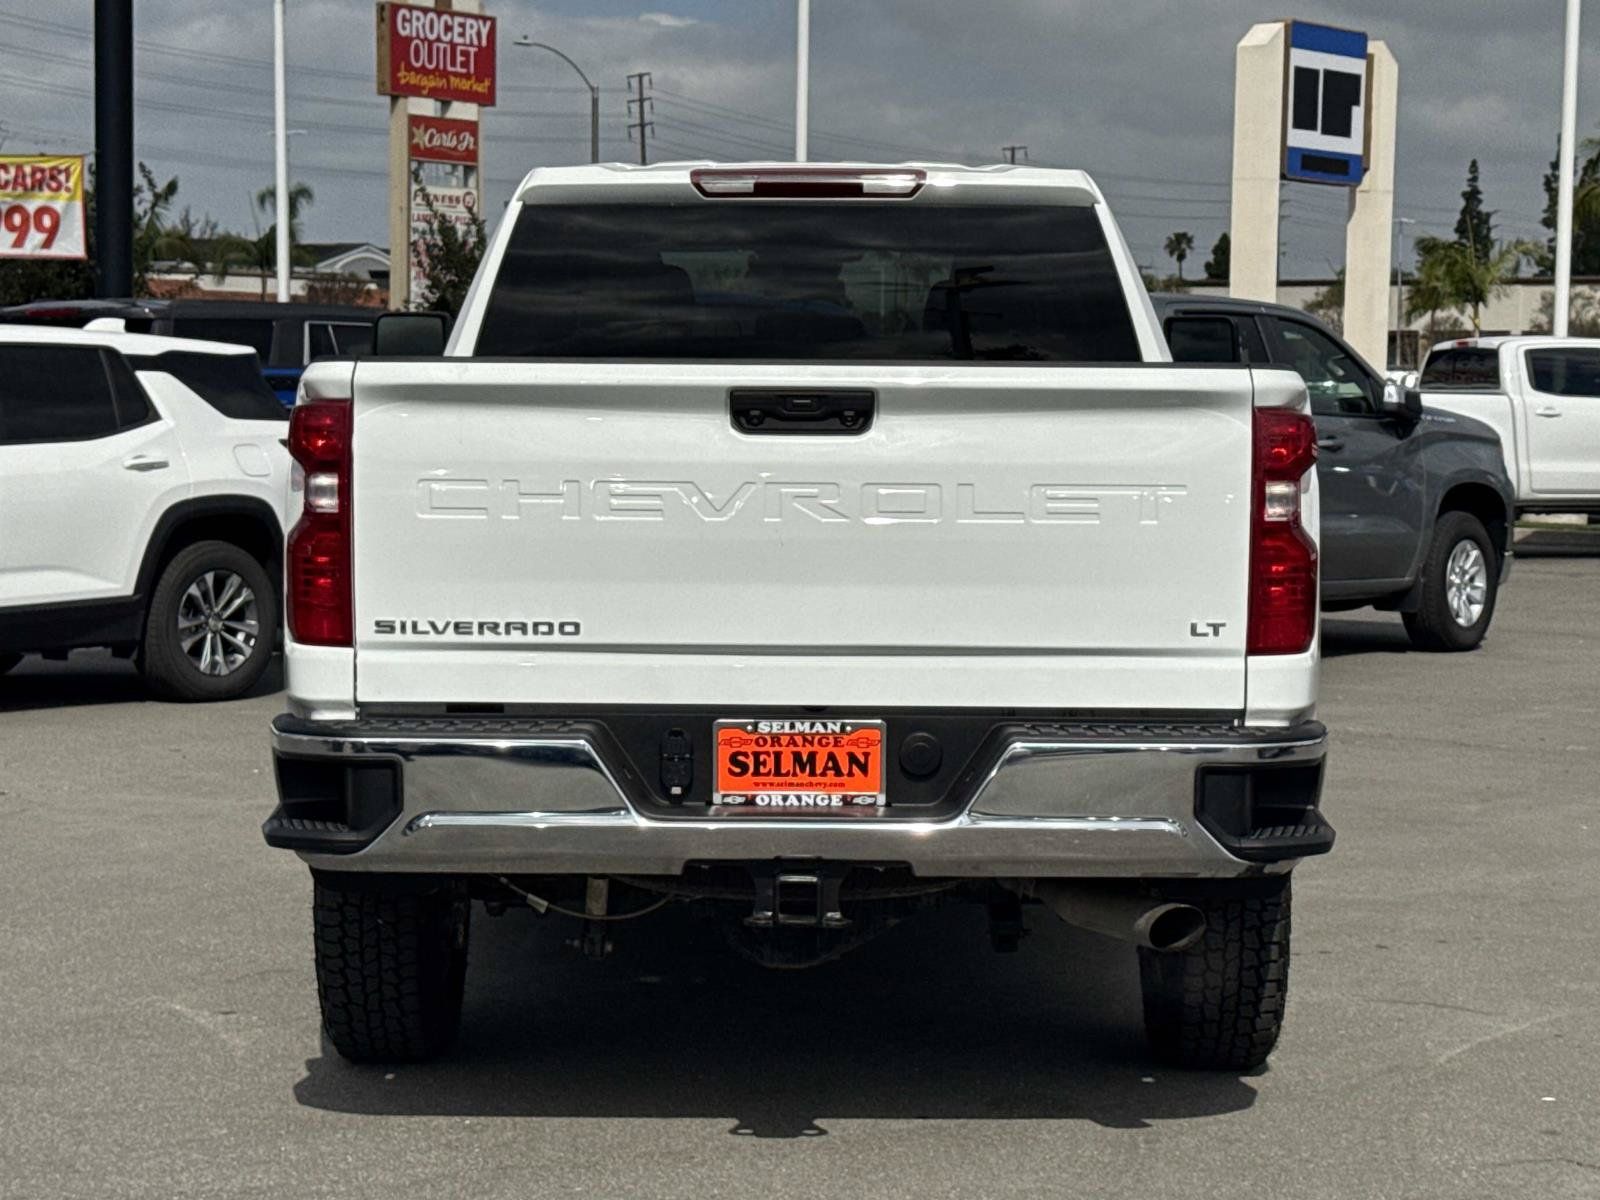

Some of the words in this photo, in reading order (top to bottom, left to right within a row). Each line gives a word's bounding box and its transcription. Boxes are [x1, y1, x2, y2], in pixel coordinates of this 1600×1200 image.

[396, 8, 491, 48] GROCERY
[409, 38, 478, 74] OUTLET
[397, 61, 448, 95] bargain
[0, 204, 61, 250] 99
[416, 478, 1188, 527] CHEVROLET
[374, 619, 581, 636] SILVERADO
[1190, 622, 1226, 637] LT
[757, 721, 842, 734] SELMAN
[754, 736, 845, 748] ORANGE
[727, 750, 871, 778] SELMAN
[753, 781, 846, 789] www.selmanchevy.com
[755, 794, 843, 806] ORANGE
